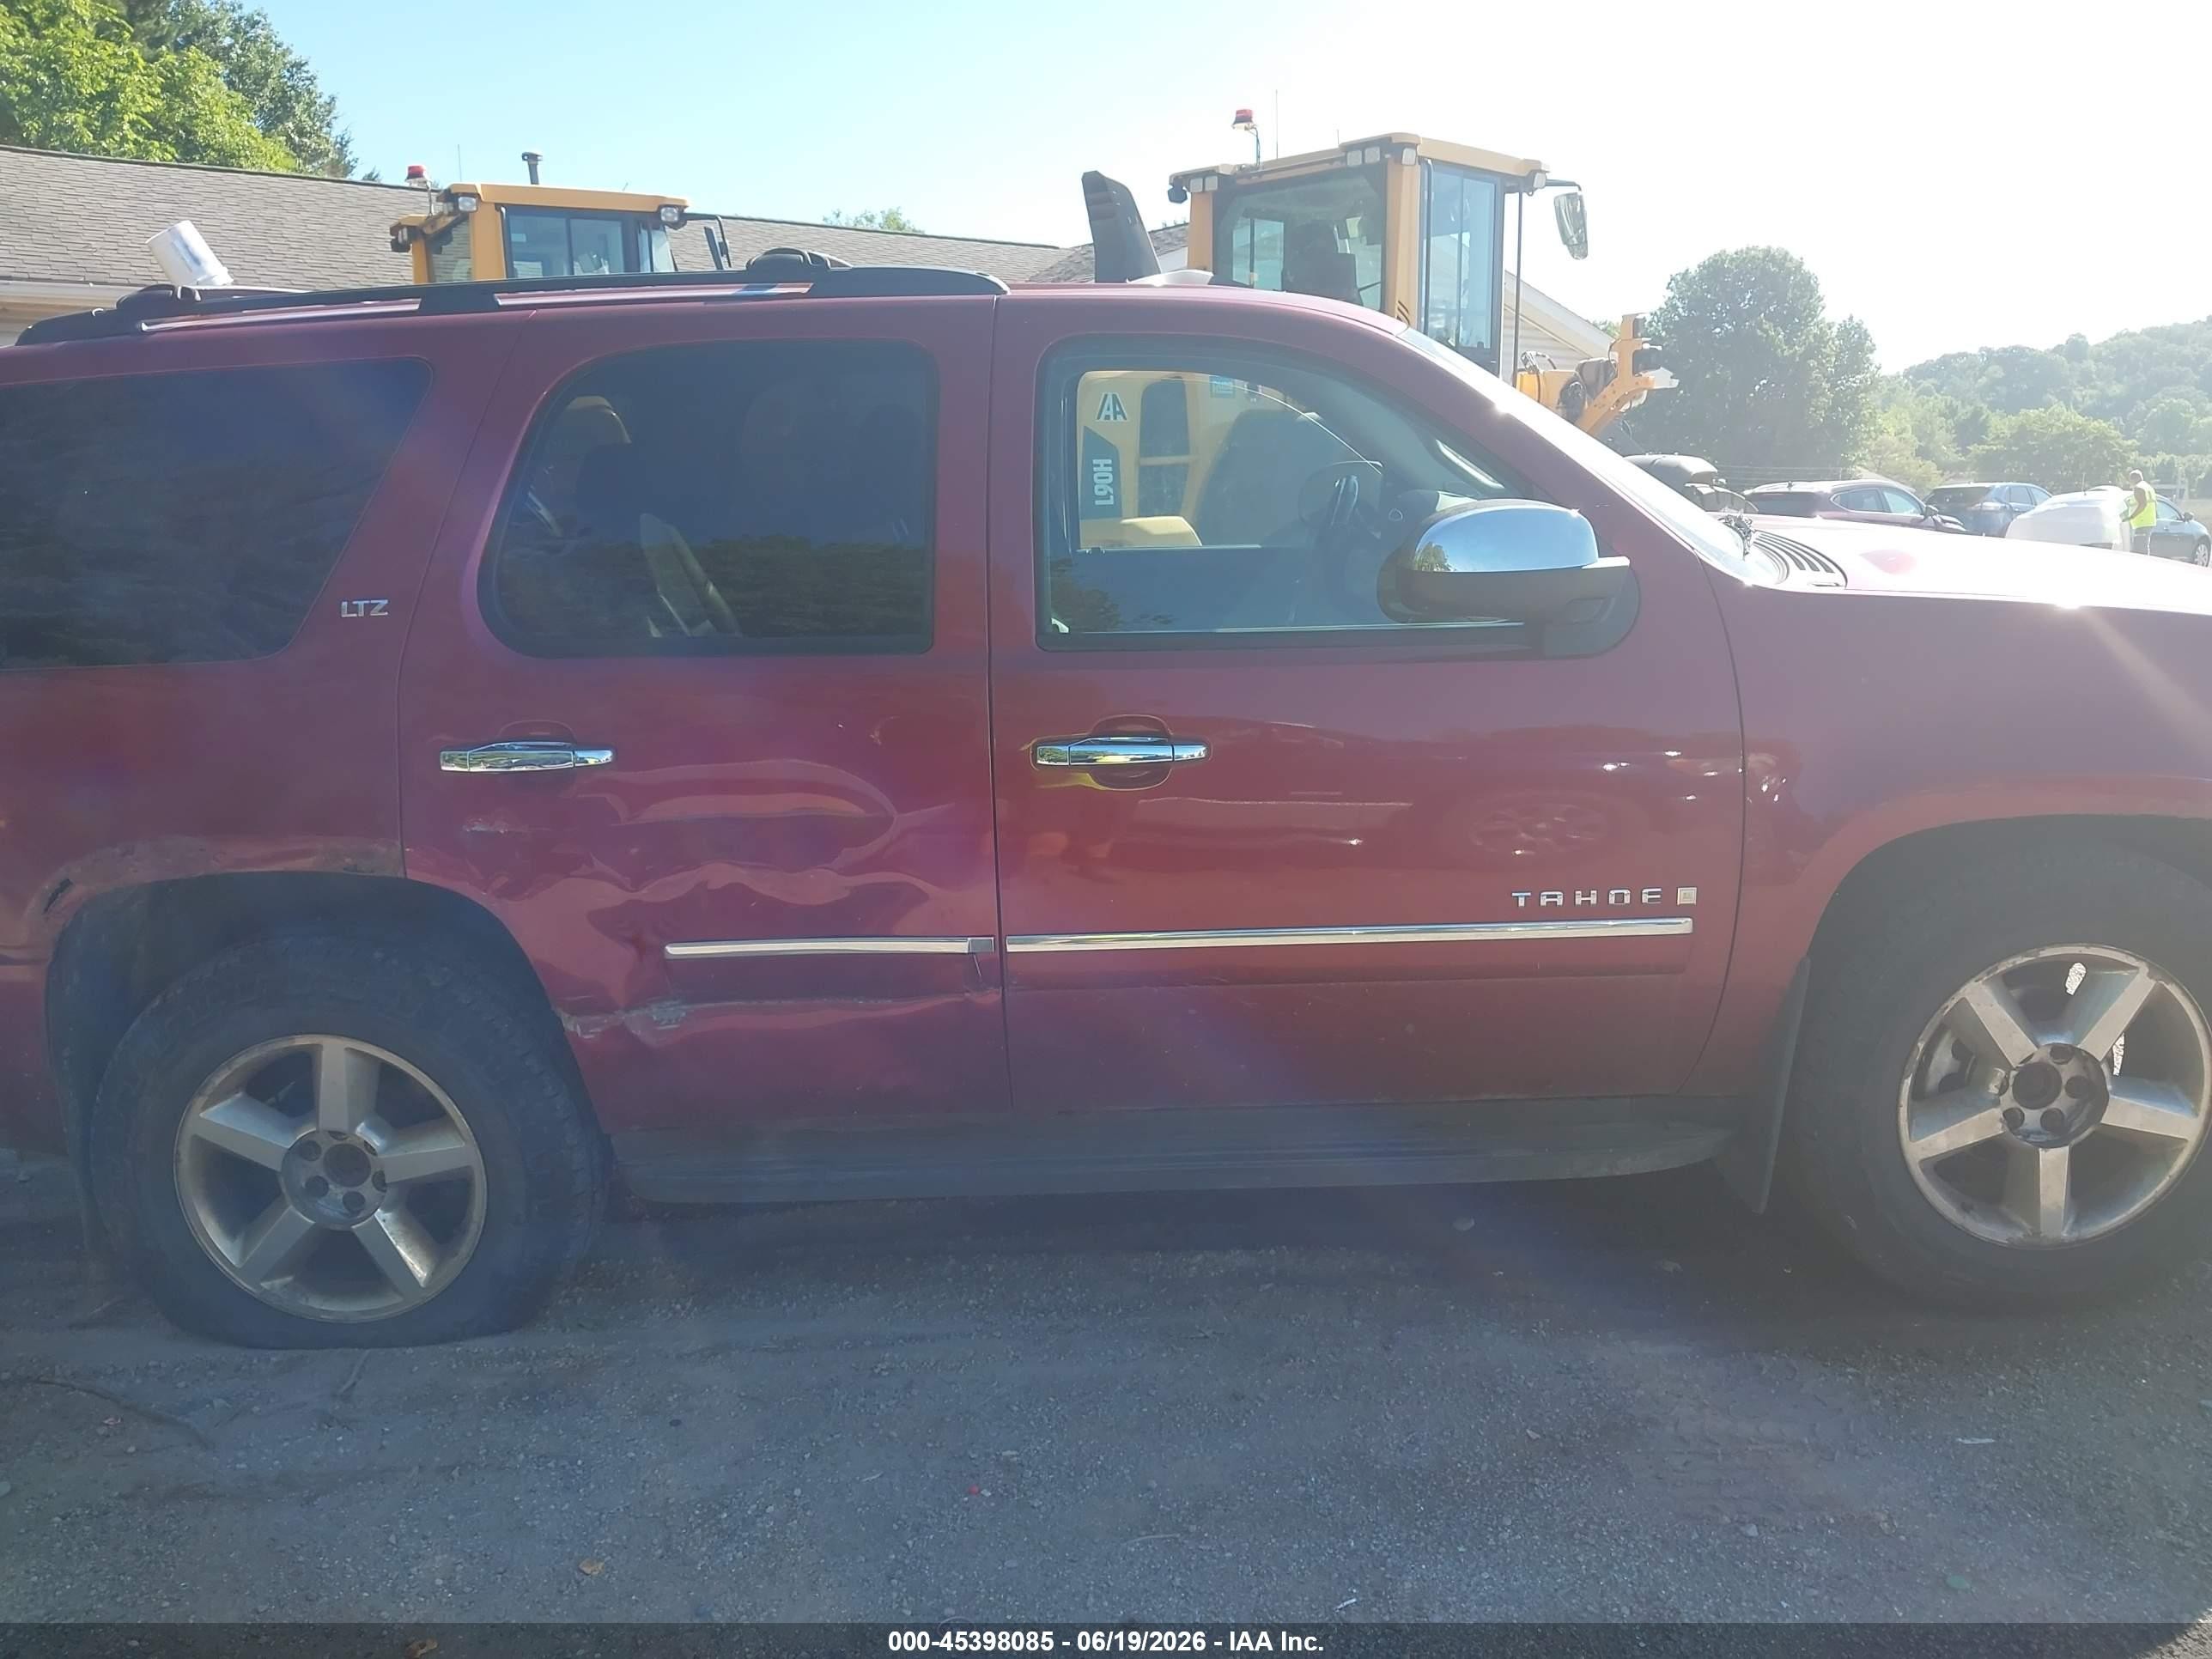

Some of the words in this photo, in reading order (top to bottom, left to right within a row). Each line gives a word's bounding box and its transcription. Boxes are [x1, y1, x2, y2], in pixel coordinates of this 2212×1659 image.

[1092, 459, 1115, 506] L90H
[341, 599, 389, 617] LTZ
[1511, 888, 1663, 907] TAHOE
